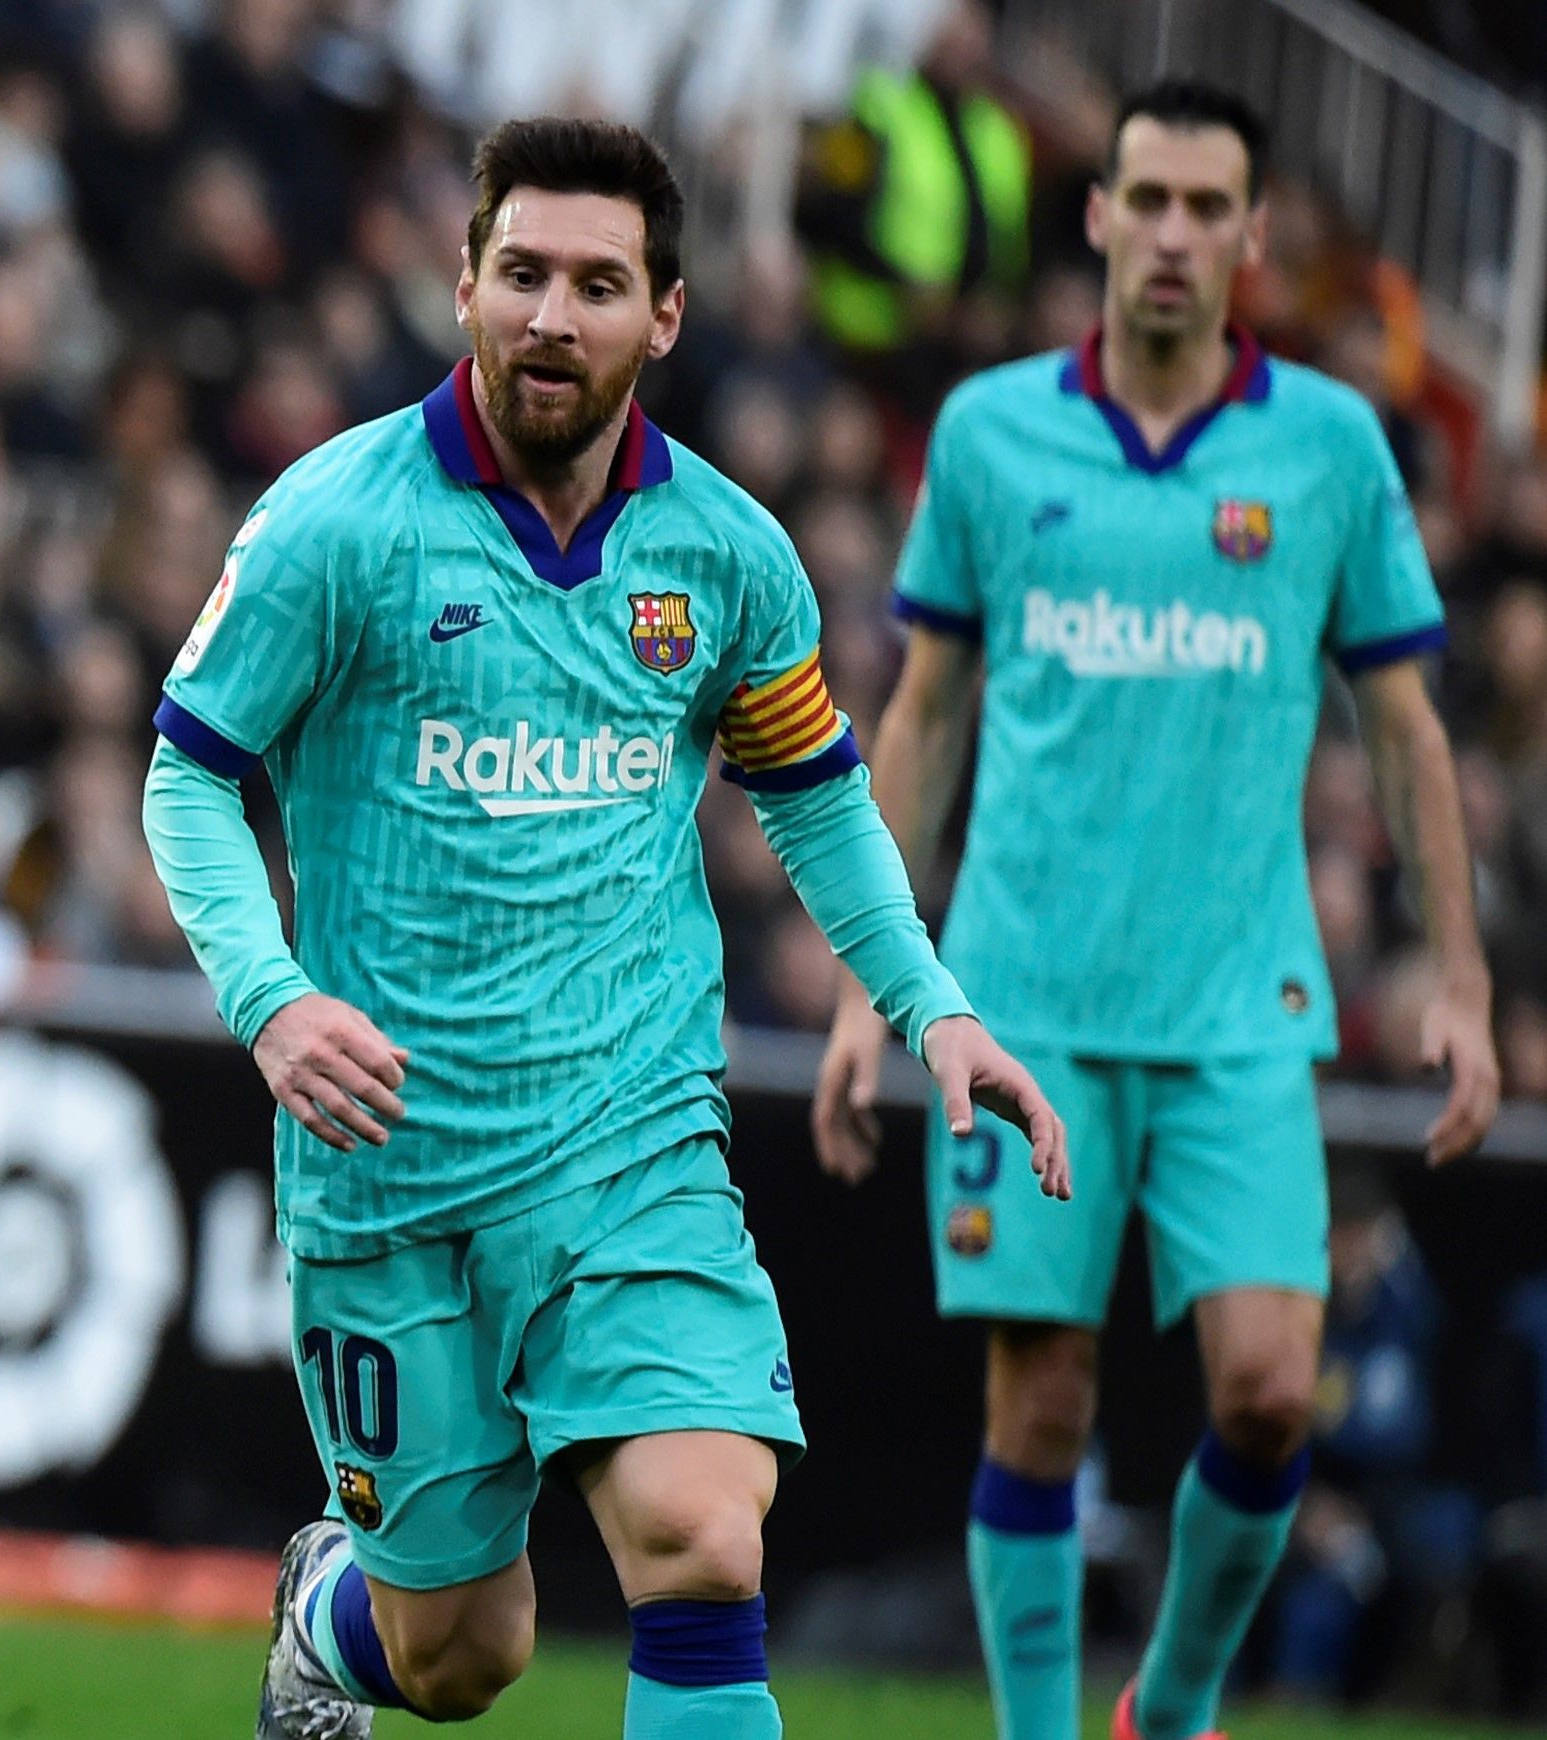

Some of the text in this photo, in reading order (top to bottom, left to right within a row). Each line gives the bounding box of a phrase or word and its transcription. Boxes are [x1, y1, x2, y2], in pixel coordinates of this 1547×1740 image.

[439, 603, 484, 625] NIKE
[1022, 586, 1268, 676] Rakuten
[415, 718, 675, 792] Rakuten
[298, 1326, 399, 1463] 10
